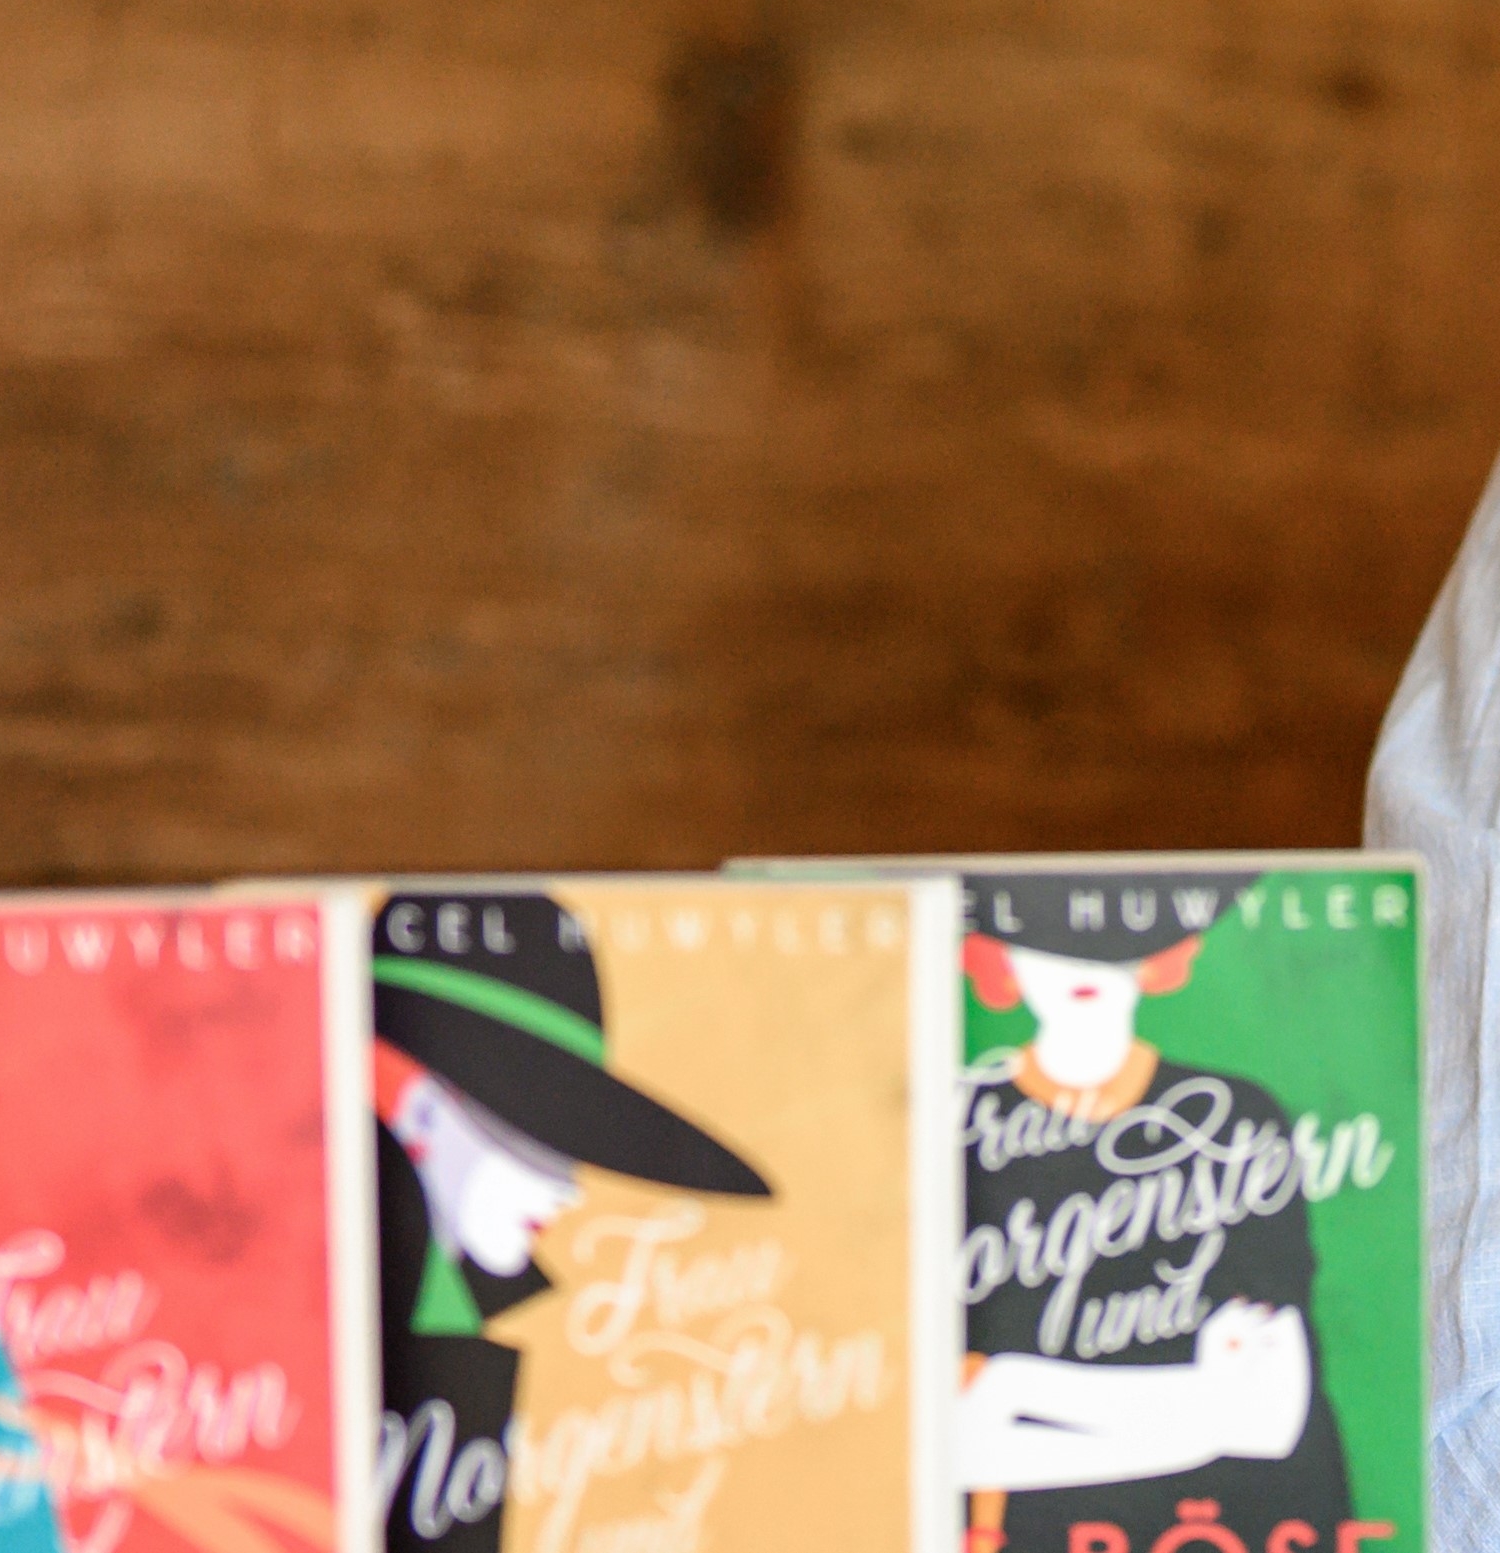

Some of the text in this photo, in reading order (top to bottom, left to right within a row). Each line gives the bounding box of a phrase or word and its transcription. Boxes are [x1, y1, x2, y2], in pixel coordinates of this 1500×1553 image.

[385, 901, 518, 954] CEL
[1068, 882, 1412, 934] HUWYLER
[956, 1074, 1396, 1356] orgenstern
[1074, 1222, 1226, 1360] und
